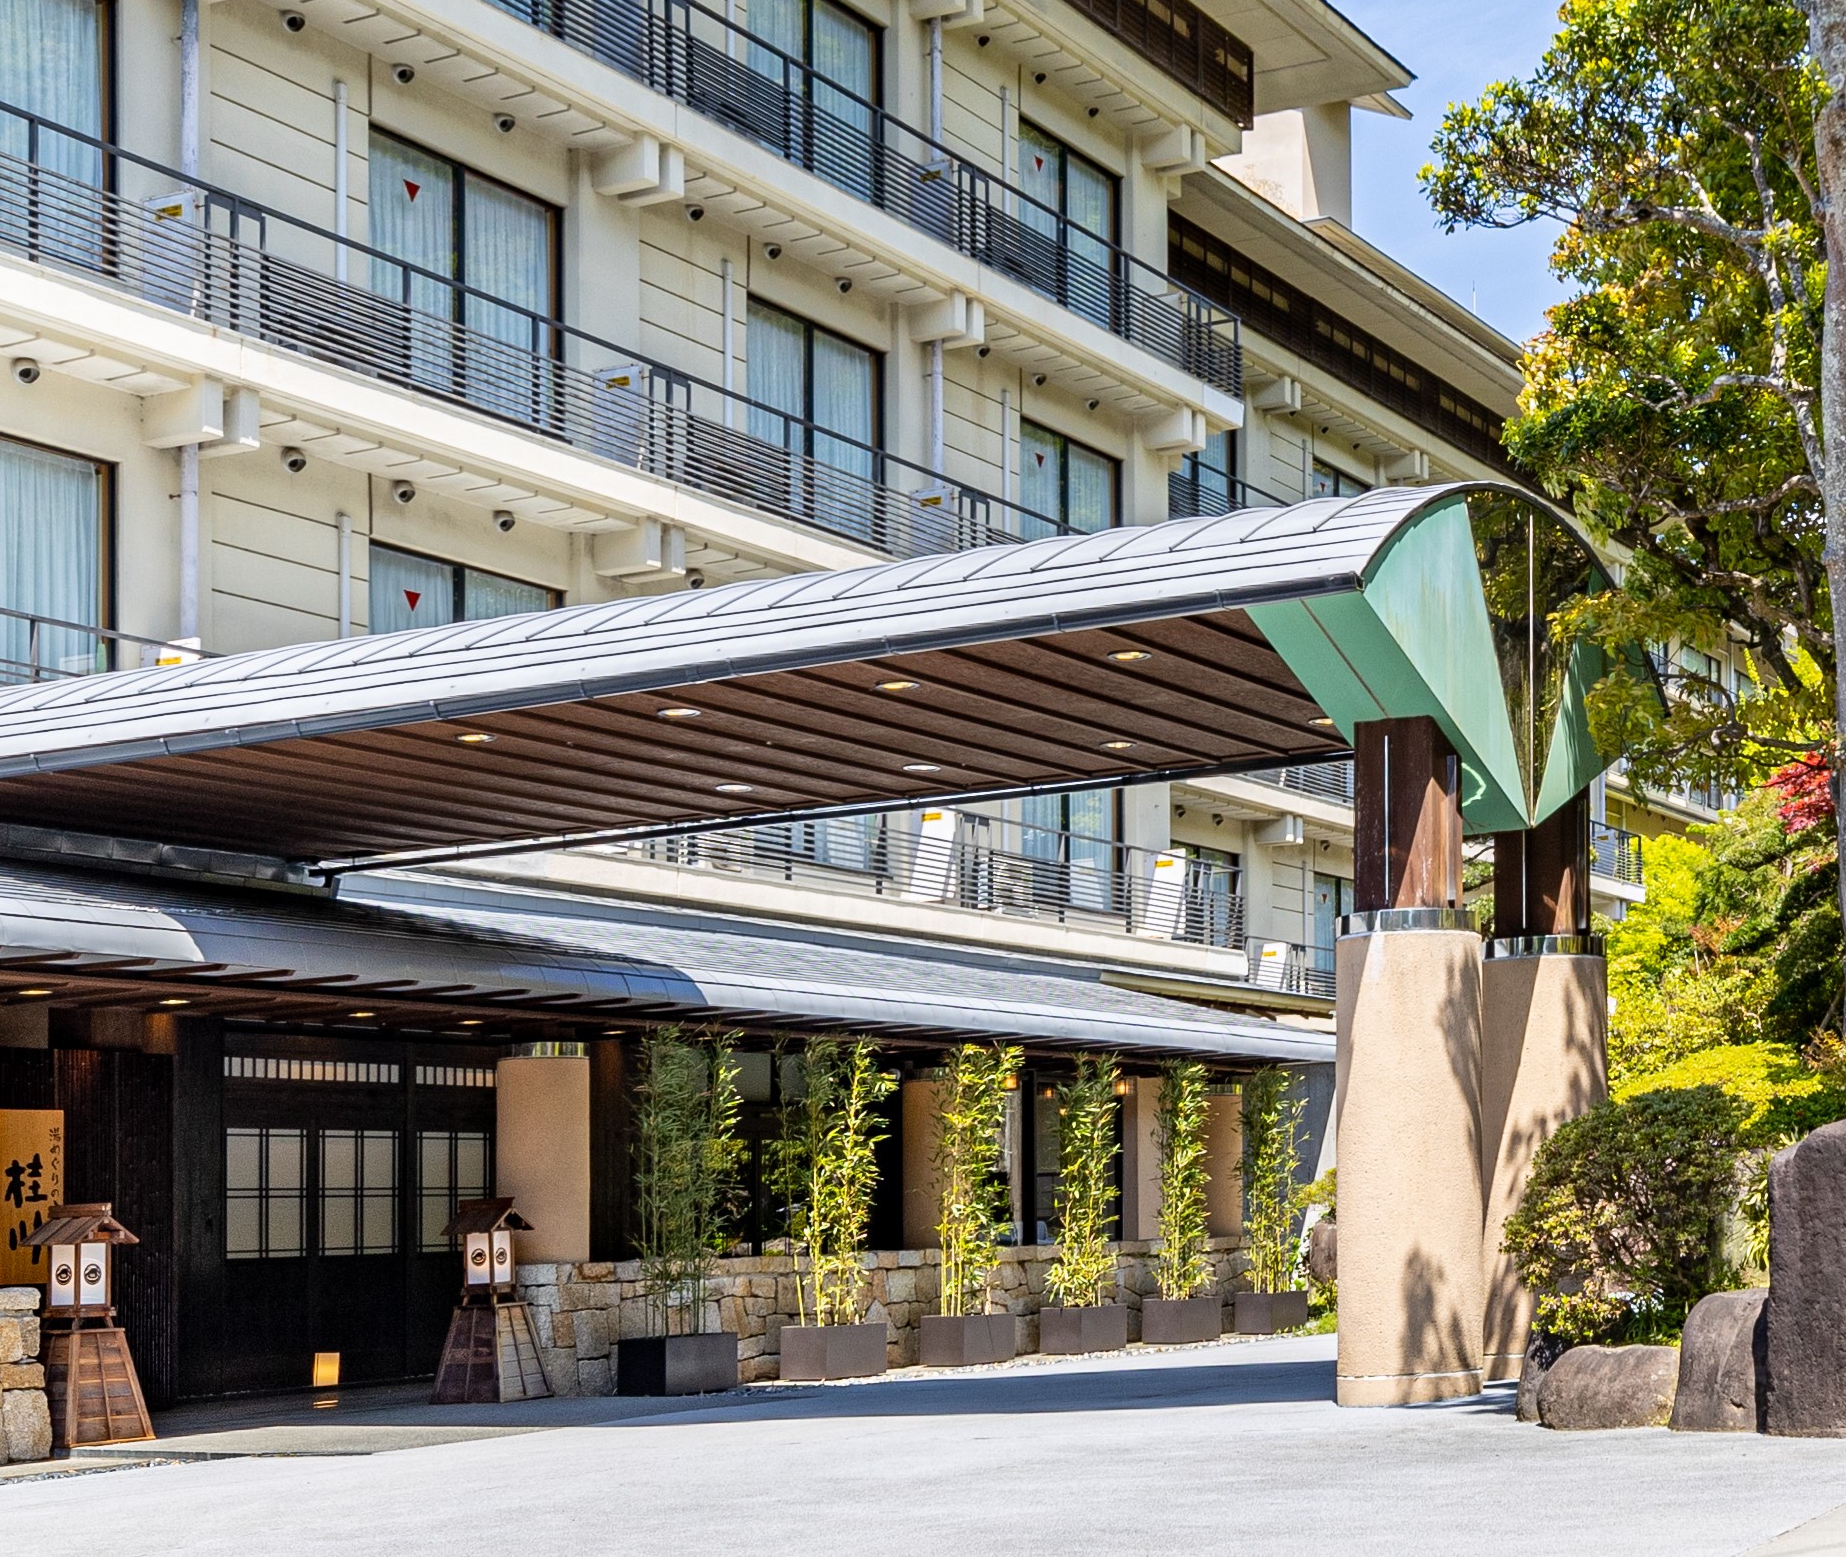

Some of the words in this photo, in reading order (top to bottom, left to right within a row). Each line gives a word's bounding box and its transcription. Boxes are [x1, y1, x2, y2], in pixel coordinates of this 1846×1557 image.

[5, 1153, 48, 1265] 桂川
[49, 1127, 61, 1206] 湯めぐりの
